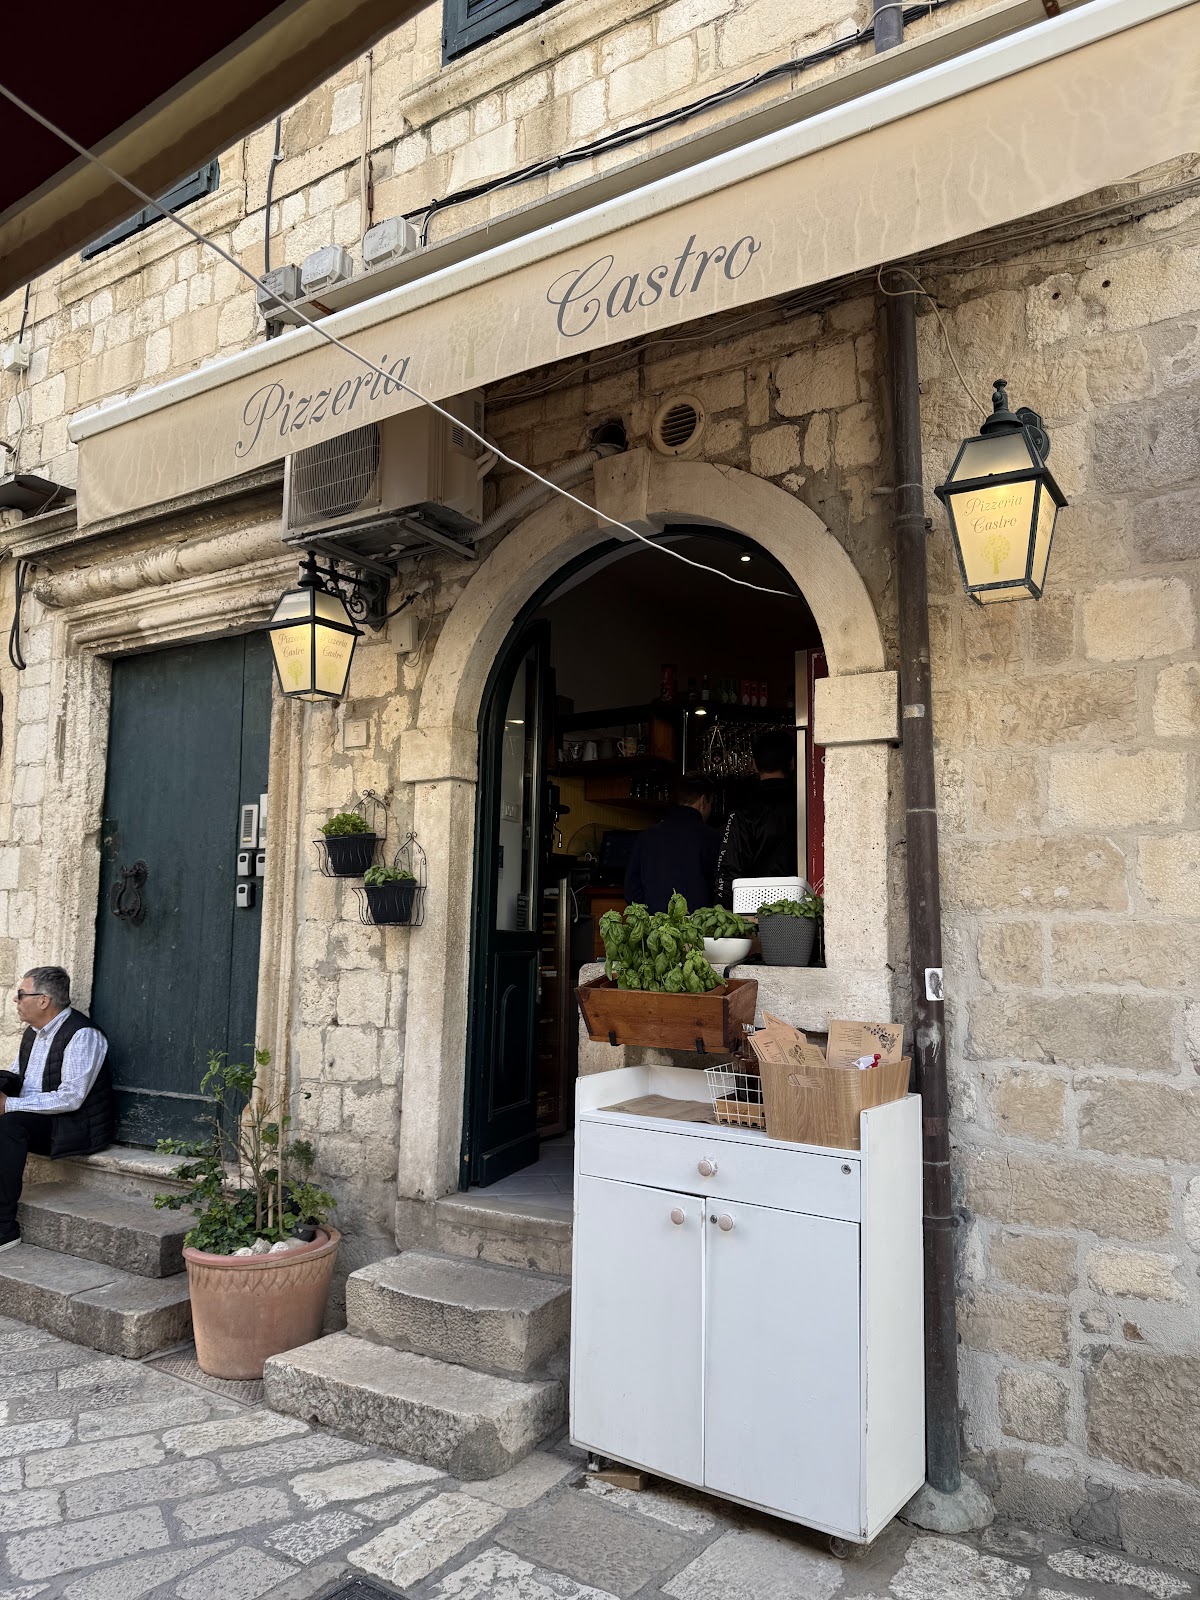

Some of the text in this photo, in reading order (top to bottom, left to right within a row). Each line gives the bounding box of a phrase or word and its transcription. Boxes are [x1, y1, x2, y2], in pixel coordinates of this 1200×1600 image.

[234, 234, 762, 458] Pizzeria Castro
[964, 495, 1023, 516] Pizzeria
[970, 515, 1017, 533] Castro
[278, 633, 306, 646] Pizzeria
[282, 646, 305, 658] Castro
[722, 812, 736, 844] KAPPA
